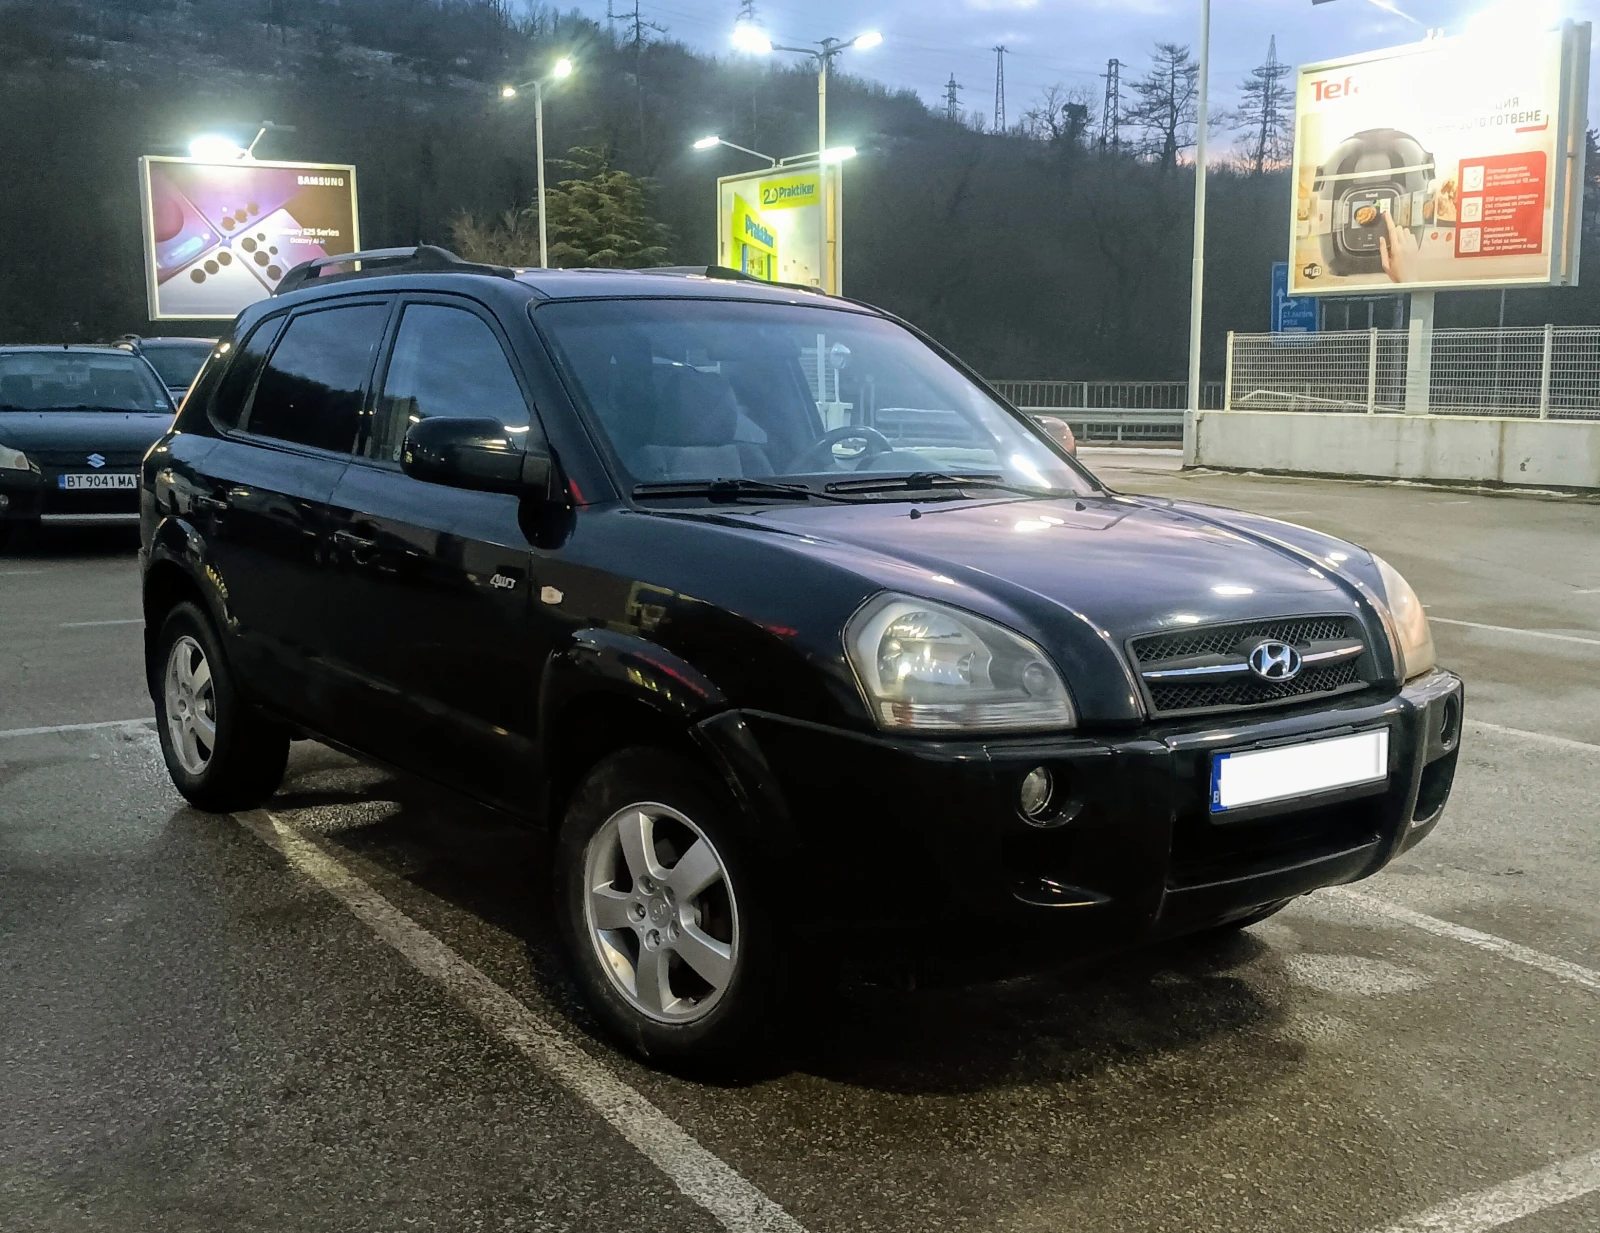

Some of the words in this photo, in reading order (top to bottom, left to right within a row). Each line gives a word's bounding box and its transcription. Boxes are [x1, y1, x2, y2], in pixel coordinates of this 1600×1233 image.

[1490, 109, 1542, 126] ГОТВЕНЕ
[297, 176, 344, 186] SAMSUNG
[778, 183, 815, 198] Praktiker
[303, 228, 315, 236] S25
[317, 228, 340, 236] Series
[67, 475, 83, 487] BT
[86, 475, 115, 487] 9041
[118, 475, 134, 487] MA
